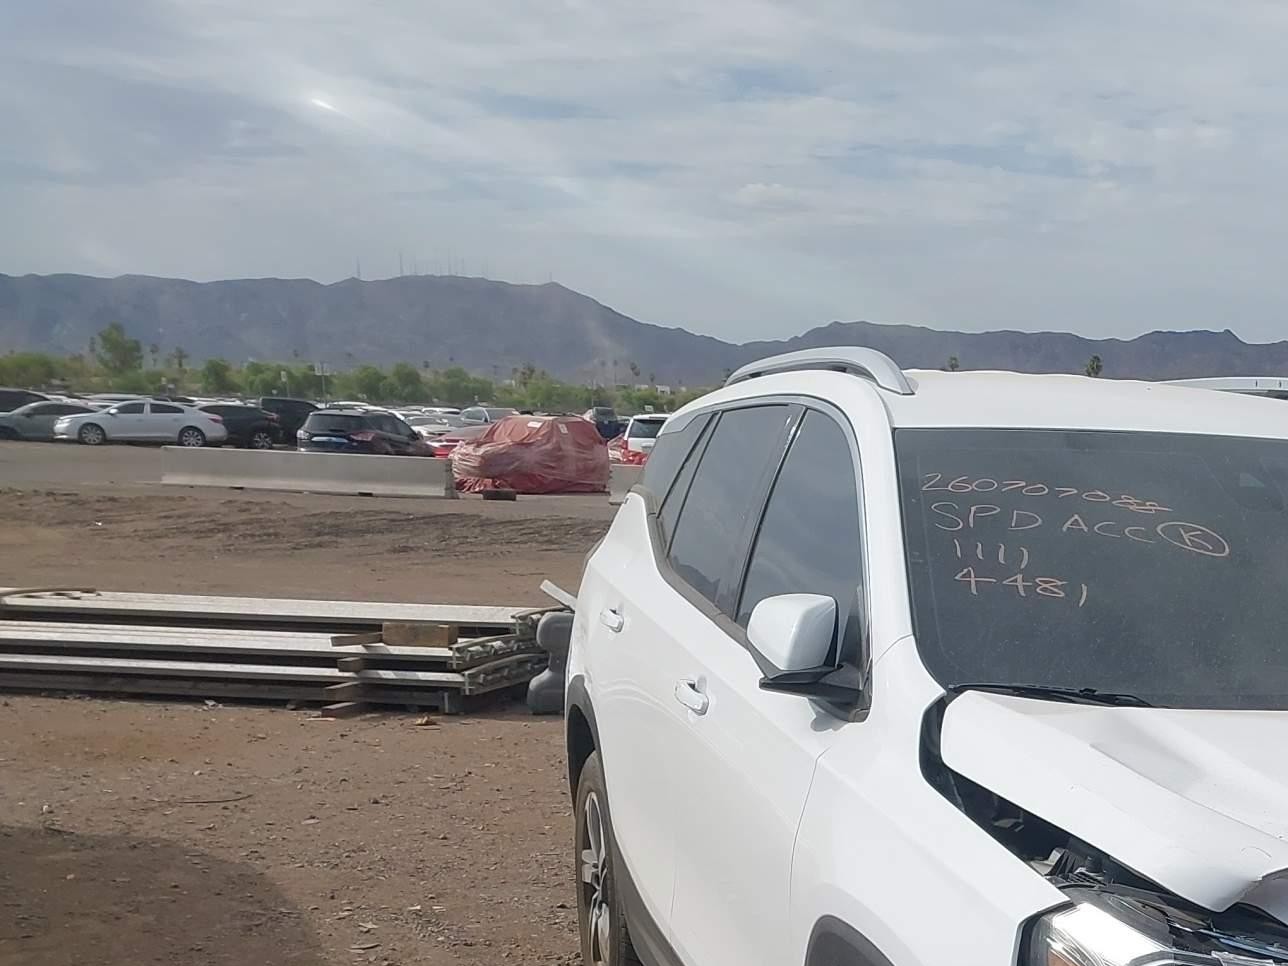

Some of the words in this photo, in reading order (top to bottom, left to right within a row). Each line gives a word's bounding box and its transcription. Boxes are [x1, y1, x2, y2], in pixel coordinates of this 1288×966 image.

[931, 502, 1042, 531] SPD
[1062, 514, 1157, 543] ACC
[953, 538, 1030, 570] 1111
[954, 566, 1088, 608] 4481
